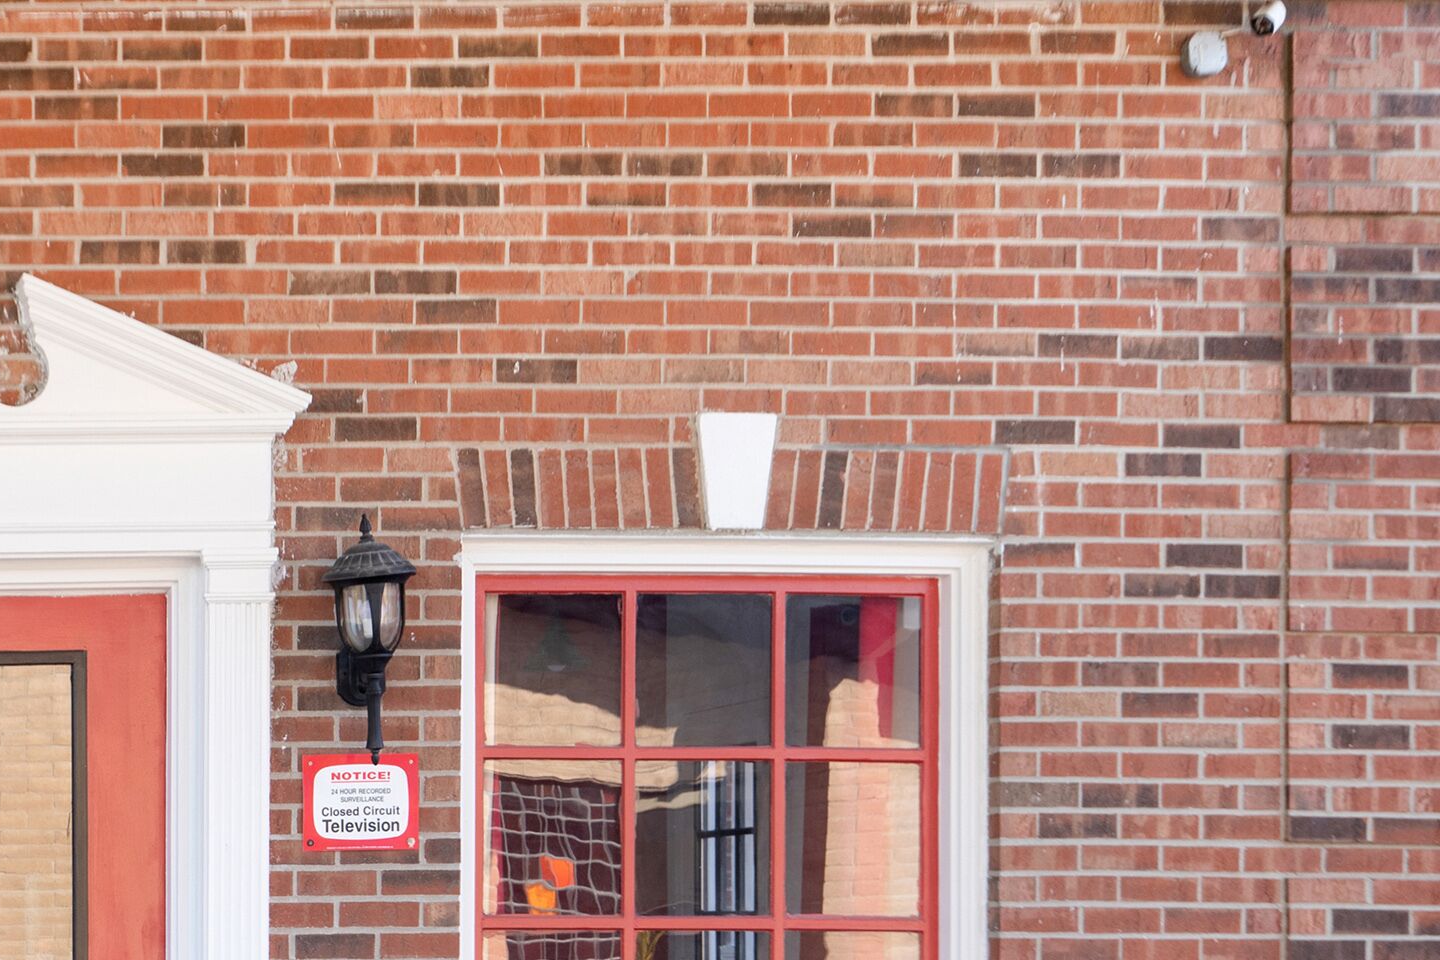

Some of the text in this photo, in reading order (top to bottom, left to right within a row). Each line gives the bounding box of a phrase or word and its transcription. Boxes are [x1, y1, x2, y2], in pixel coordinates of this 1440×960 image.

[331, 772, 391, 780] NOTICE!
[331, 787, 391, 795] 24 HOUR RECORDED
[321, 805, 400, 817] Closed Circuit
[322, 818, 400, 833] Television
